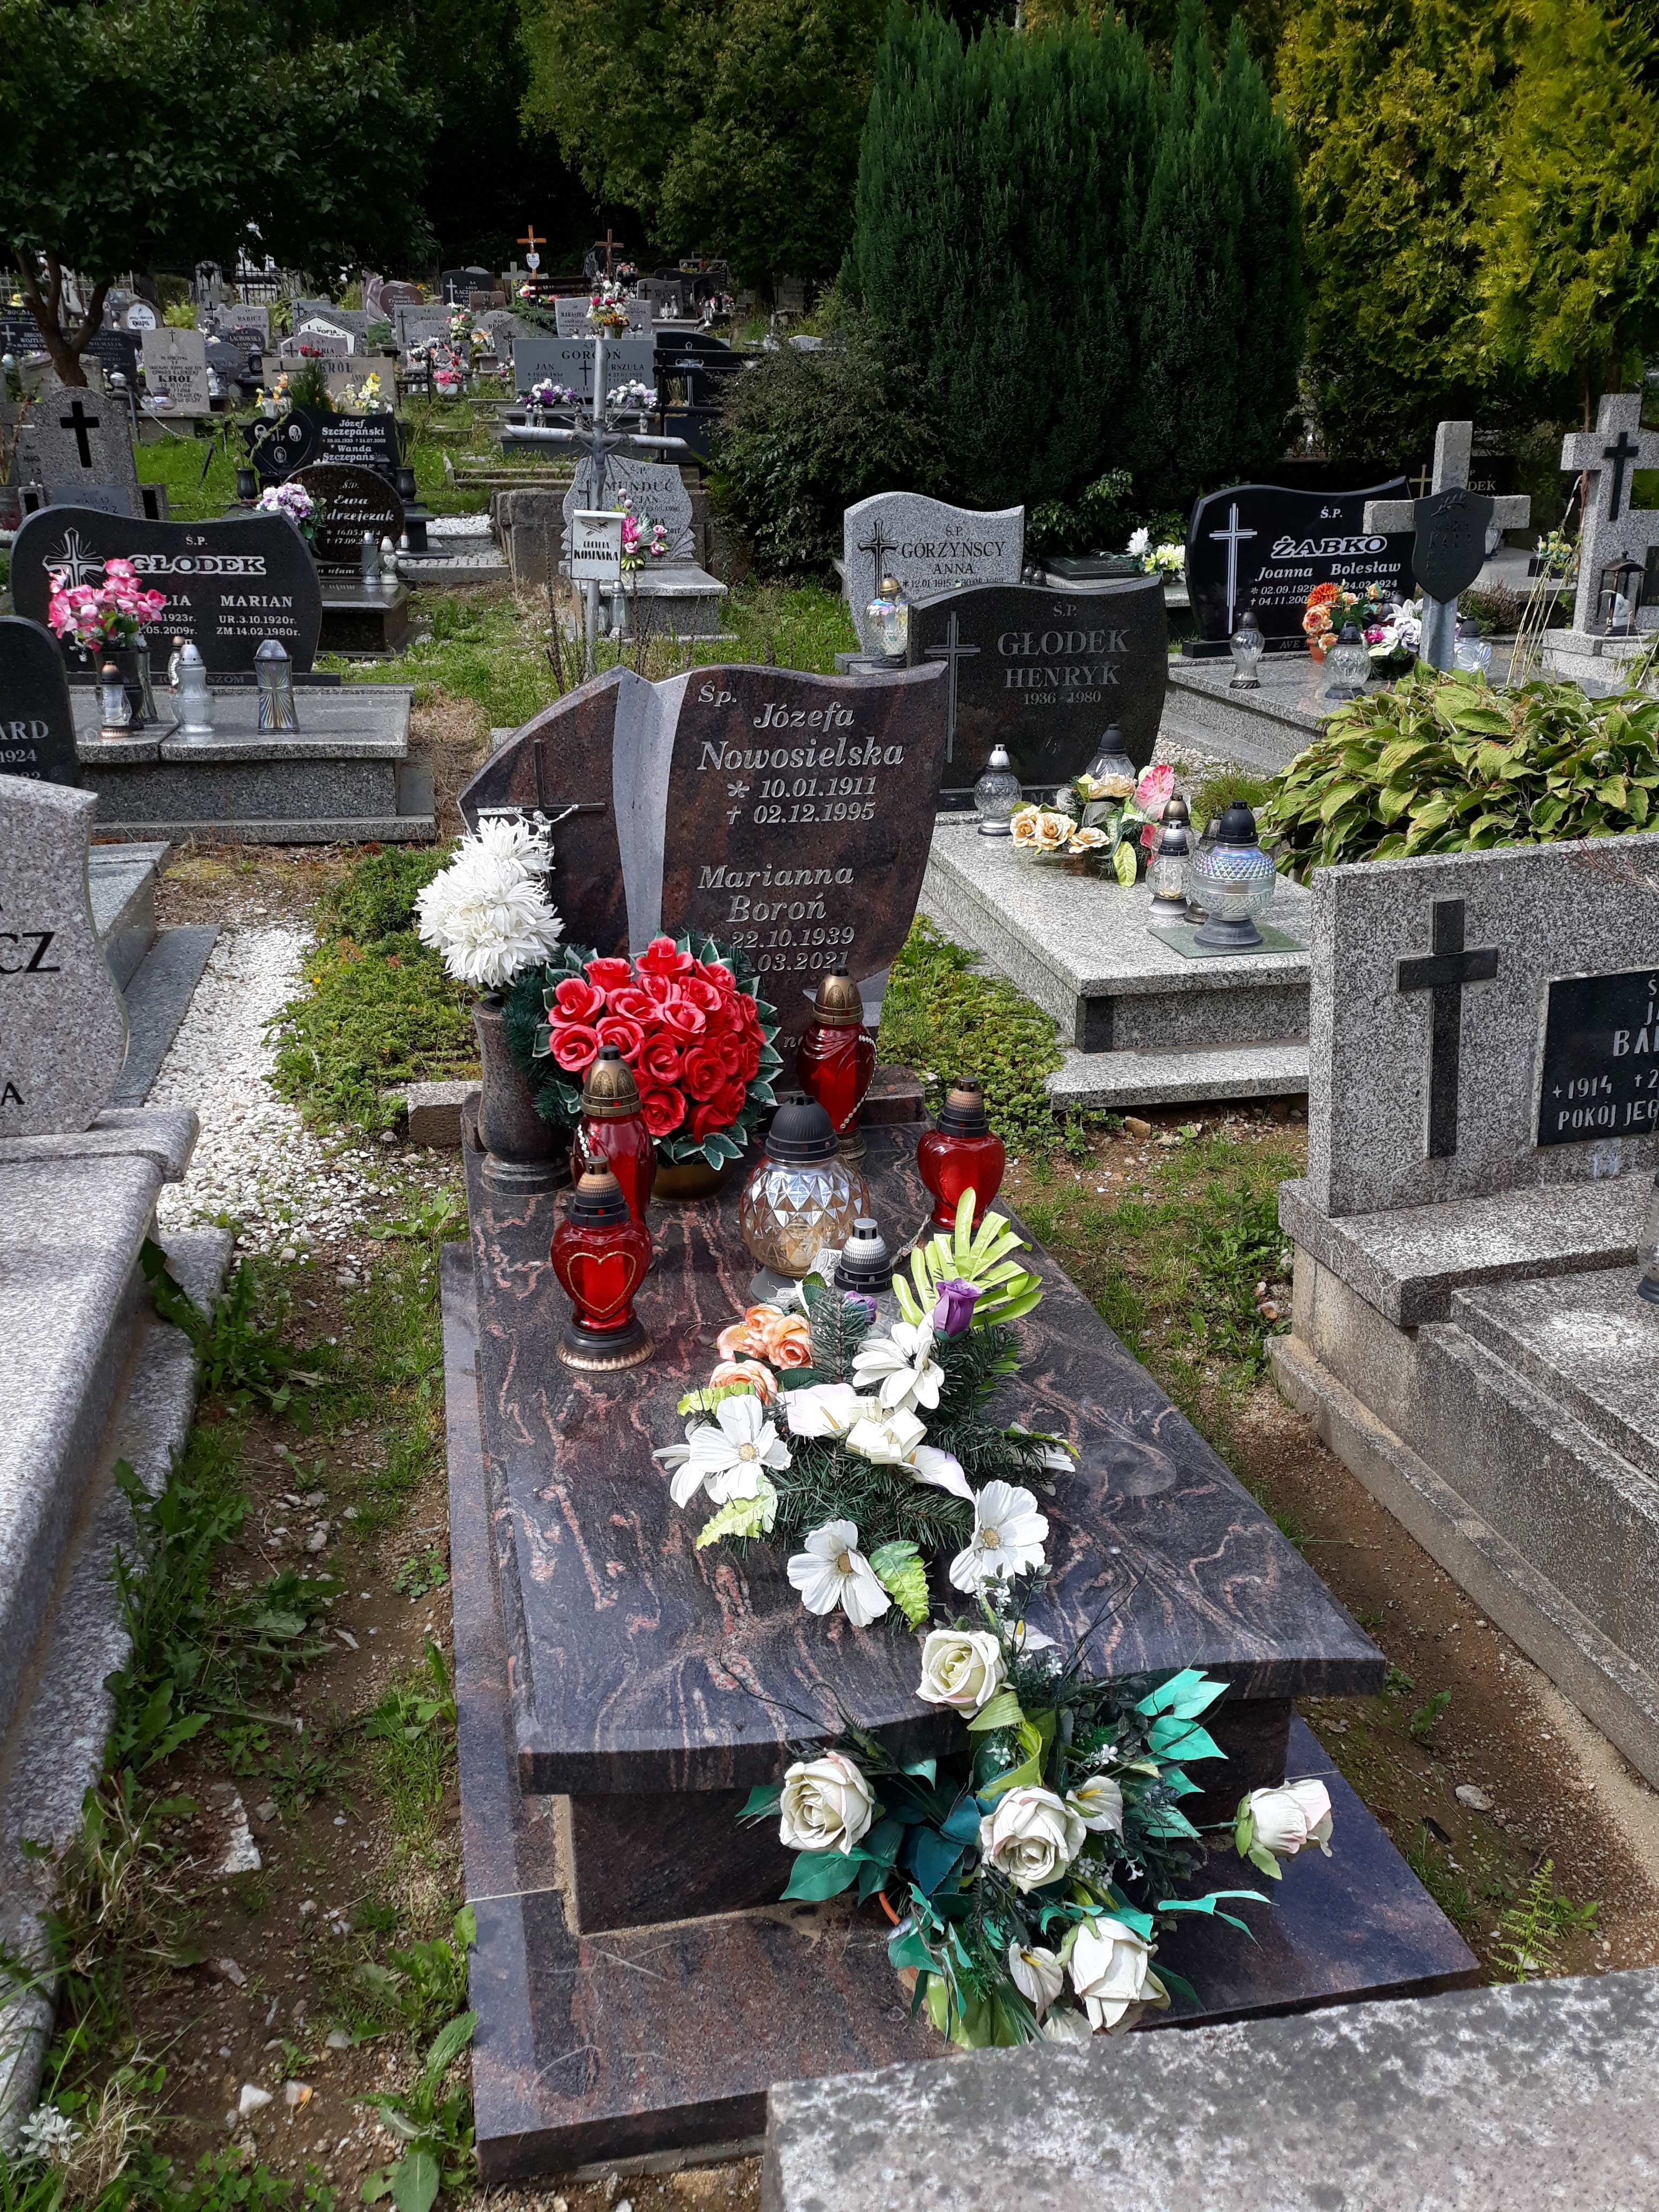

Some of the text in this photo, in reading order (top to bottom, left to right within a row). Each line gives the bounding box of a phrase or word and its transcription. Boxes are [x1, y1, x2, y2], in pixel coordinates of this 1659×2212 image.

[322, 427, 385, 438] Szczepański
[339, 419, 366, 428] Józef
[323, 452, 375, 463] Szczepańs
[338, 444, 372, 452] Wanda
[333, 495, 369, 505] Ewa
[1320, 505, 1343, 519] Ś.P.
[186, 534, 208, 545] Ś.P.
[902, 538, 1006, 558] GÓRZYŃSCY
[1271, 535, 1388, 559] ŻABKO
[328, 567, 355, 575] ufam
[933, 563, 974, 574] ANNA
[1255, 561, 1401, 581] Joanna Bolesław
[220, 595, 293, 608] MARIAN
[1053, 601, 1077, 617] Ś.P.
[997, 629, 1130, 656] GŁODEK
[1003, 665, 1120, 688] HENRYK
[697, 680, 737, 707] Śp.
[1023, 692, 1056, 705] 1936
[1067, 691, 1101, 703] 1980
[753, 701, 855, 733] Józefa
[697, 736, 905, 771] Nowosielska
[758, 775, 877, 798] 10.01.1911
[753, 802, 876, 824] 02.12.1995
[697, 863, 854, 889] Marianna
[725, 891, 827, 923] Boroń
[731, 926, 855, 949] 22.10.1939
[743, 950, 849, 973] .03.2021
[1568, 1074, 1612, 1099] 1914
[1558, 1100, 1617, 1131] POKÓJ
